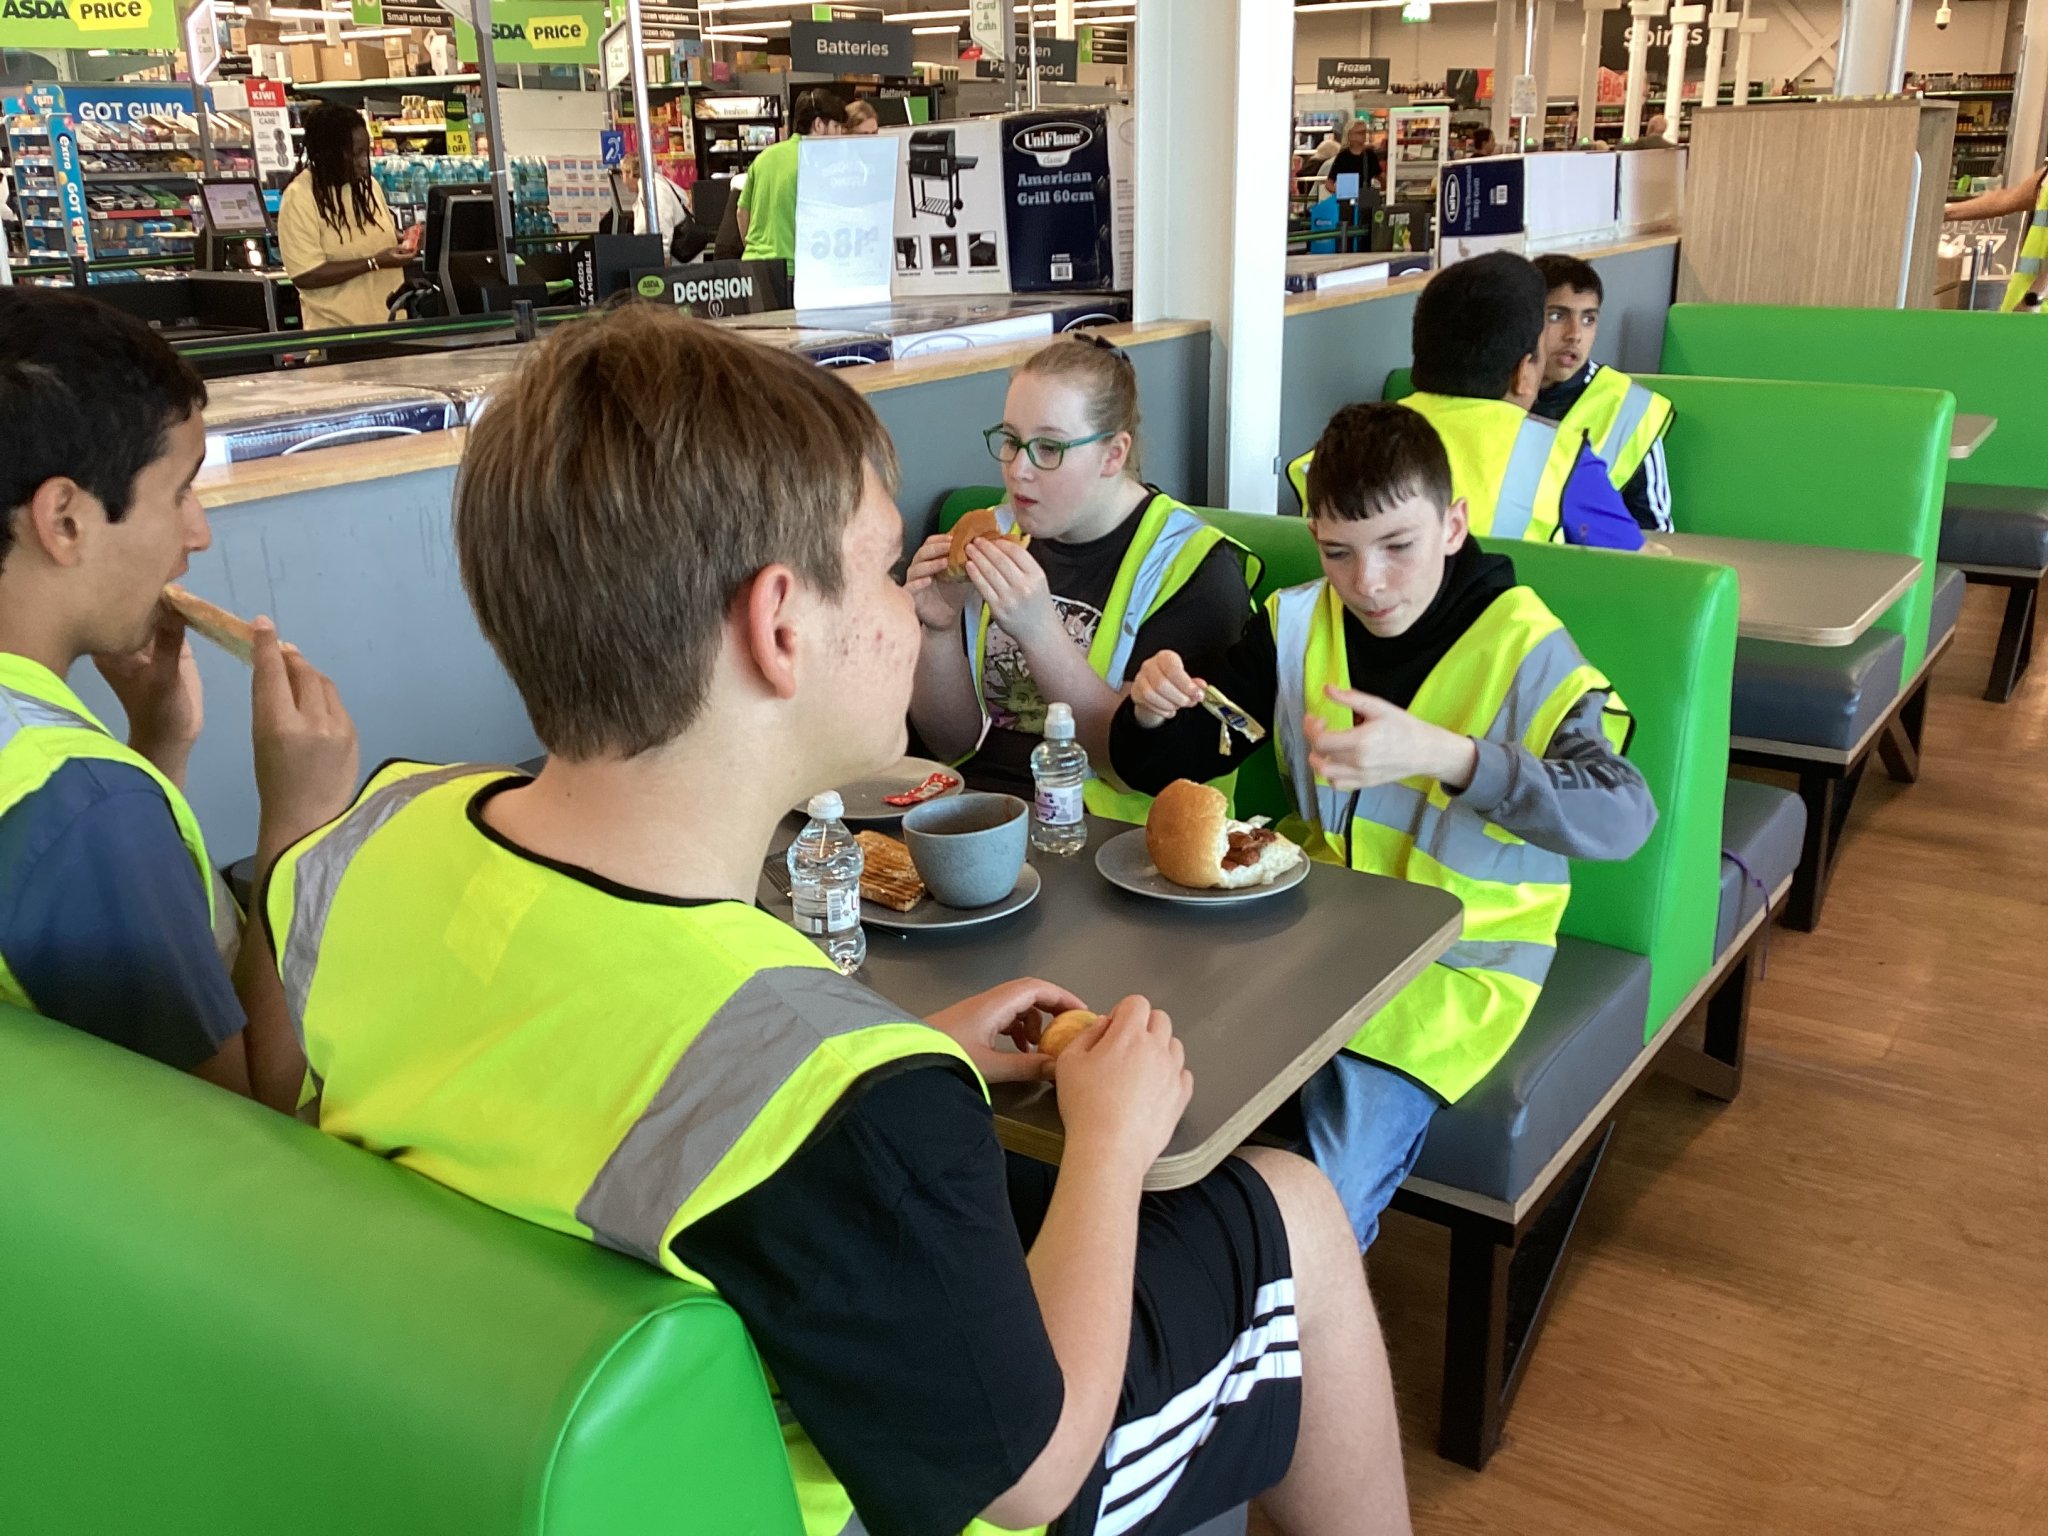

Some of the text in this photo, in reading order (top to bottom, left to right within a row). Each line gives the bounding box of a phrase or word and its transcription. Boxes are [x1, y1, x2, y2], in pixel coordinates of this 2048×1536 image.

[2, 0, 70, 18] ASDA
[975, 1, 996, 11] Card
[386, 12, 441, 23] Small pet food
[658, 12, 689, 23] vegetables
[492, 23, 525, 40] SDA
[659, 28, 675, 38] chips
[976, 21, 997, 31] Cash
[816, 38, 889, 56] Batteries
[990, 60, 1064, 76] Pay ood
[1337, 62, 1371, 72] Frozen
[1327, 75, 1380, 87] Vegetarian
[251, 91, 276, 100] KIWI
[78, 102, 184, 122] GOT GUM?
[254, 110, 279, 118] TRAINER
[259, 117, 276, 125] CARE
[1024, 130, 1081, 149] UniFlame
[58, 135, 72, 170] extra
[452, 145, 466, 153] OFF
[1017, 171, 1092, 187] American
[67, 182, 81, 214] GOT
[1017, 190, 1095, 206] Grill 60cm
[585, 250, 594, 292] MOBILE
[577, 261, 587, 298] CARDS
[642, 281, 660, 289] ASDA
